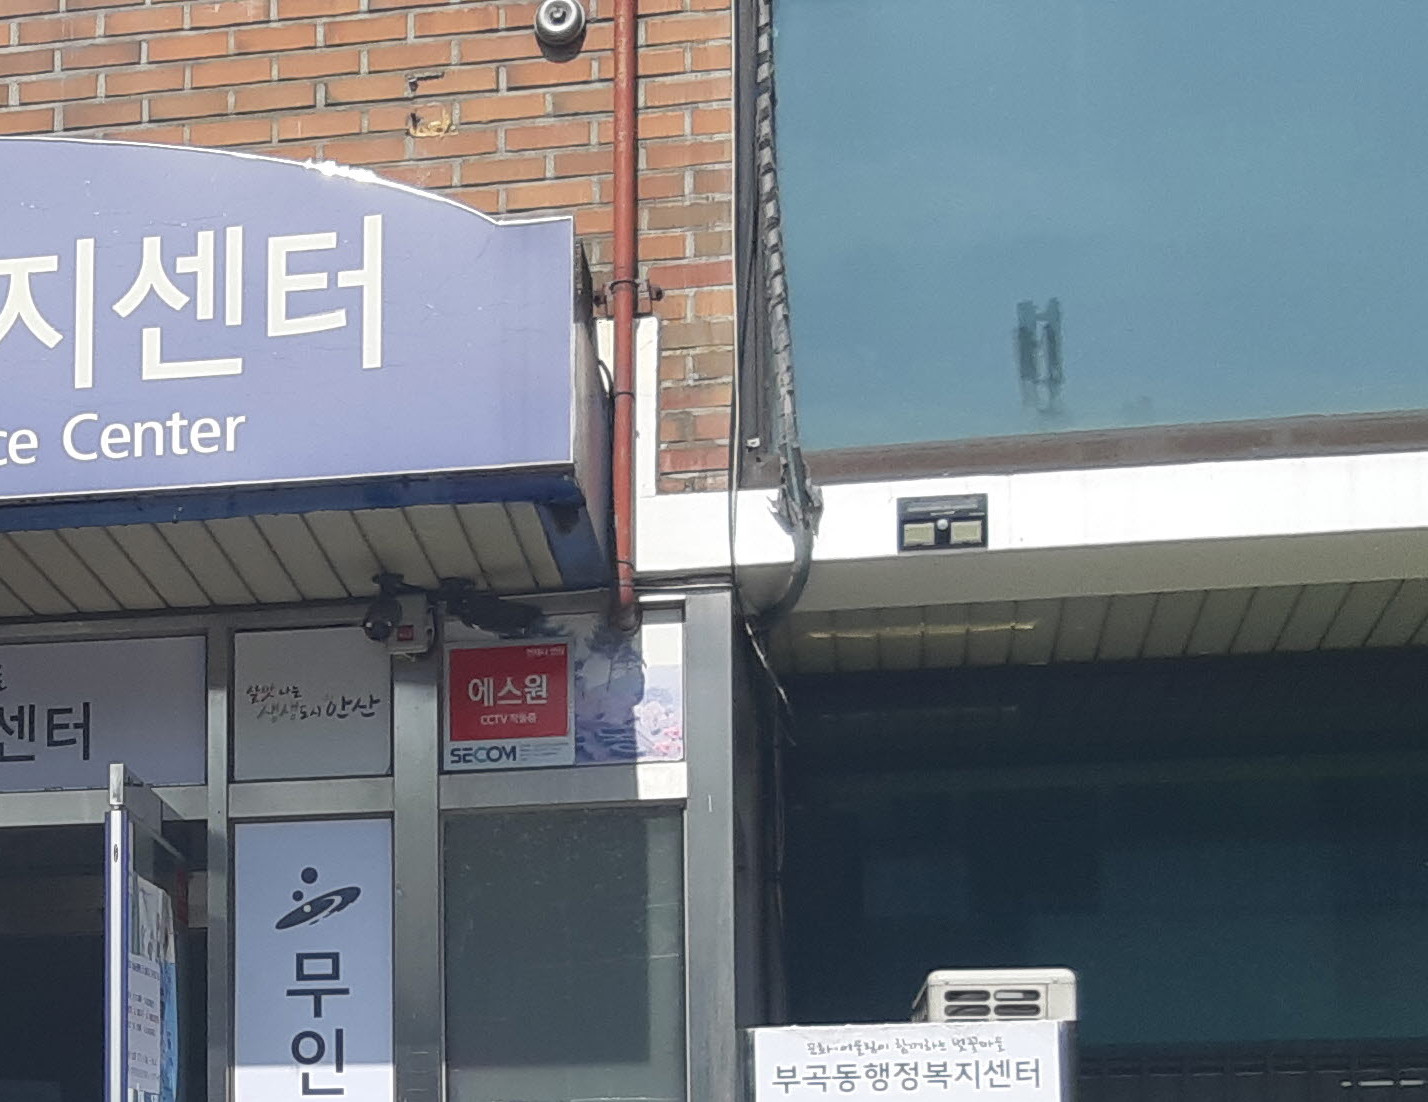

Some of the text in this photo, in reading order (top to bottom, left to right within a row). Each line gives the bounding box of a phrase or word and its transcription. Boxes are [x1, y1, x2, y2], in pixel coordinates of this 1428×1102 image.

[63, 411, 246, 465] Center
[468, 674, 548, 706] 에스원
[326, 695, 380, 718] 안산
[481, 714, 508, 725] CCTV
[451, 746, 517, 764] SECOM
[772, 1058, 1041, 1094] 부곡동행정복지센터
